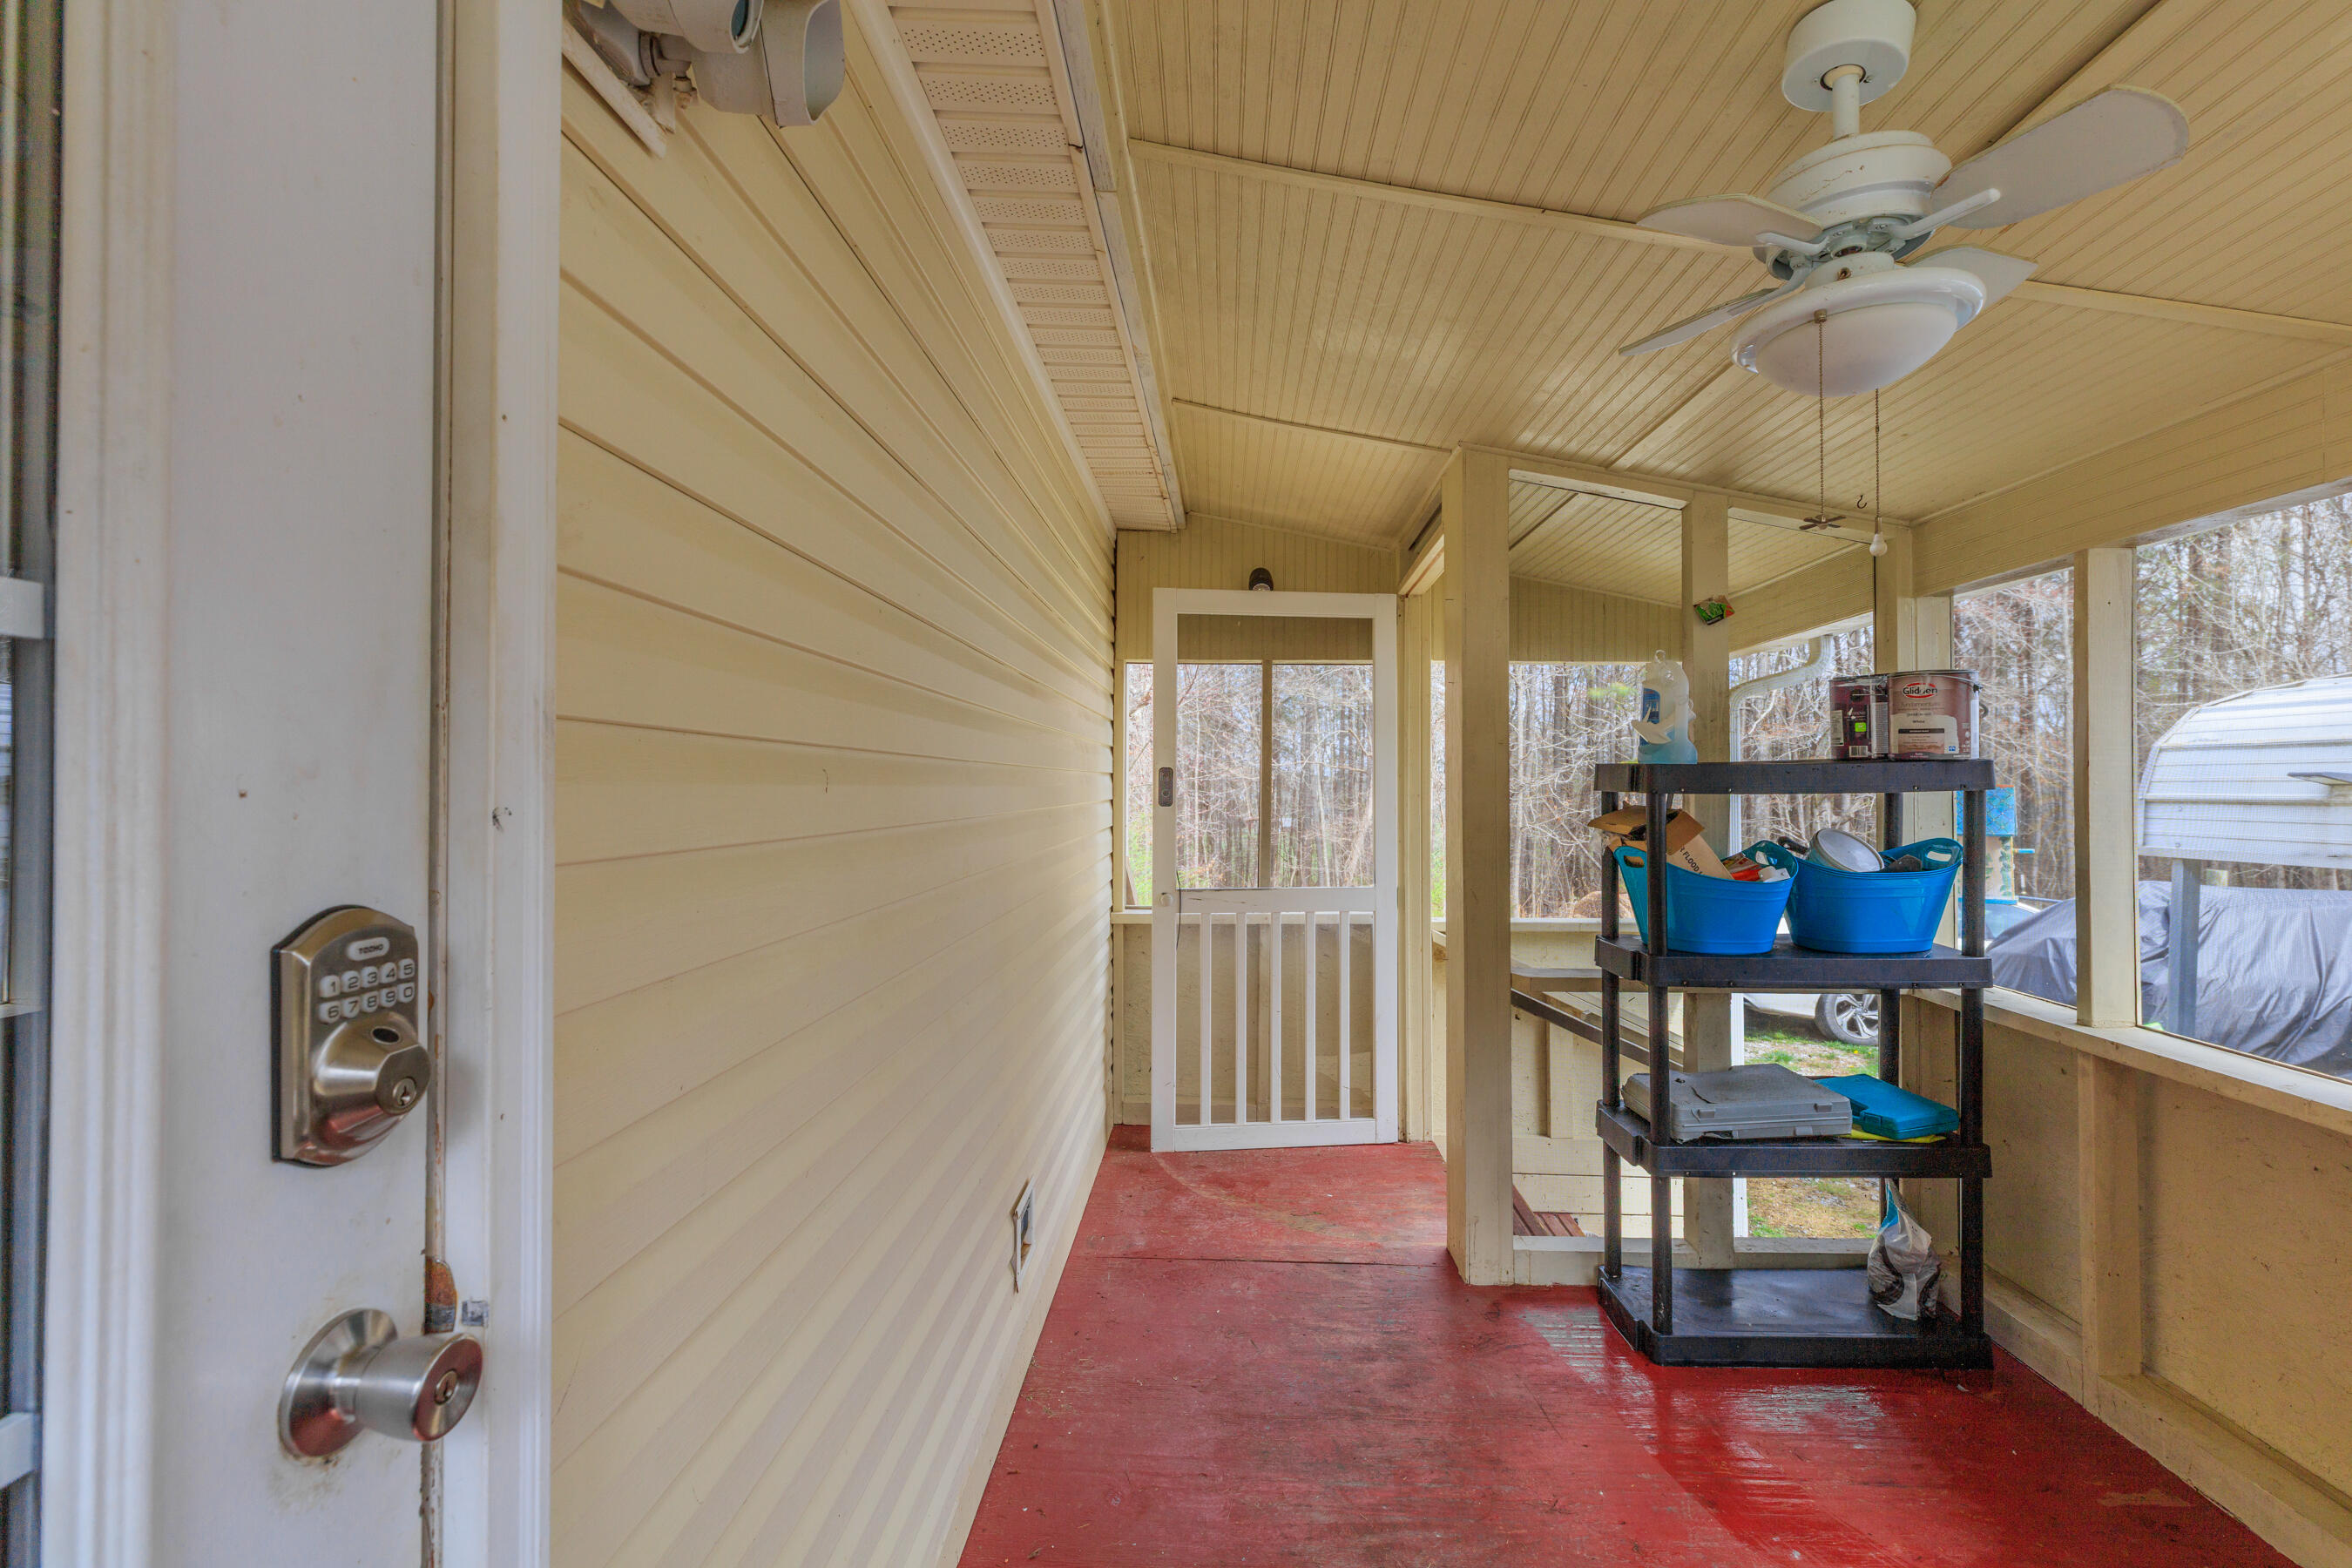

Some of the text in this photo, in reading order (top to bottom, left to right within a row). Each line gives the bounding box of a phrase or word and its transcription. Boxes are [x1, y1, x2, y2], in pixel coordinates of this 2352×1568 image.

[1682, 850, 1700, 872] FLOOD
[348, 976, 359, 990] 2
[368, 971, 378, 984] 3
[386, 968, 395, 979] 4
[403, 963, 414, 976] 5
[328, 986, 413, 1018] 6 7 8 9 0
